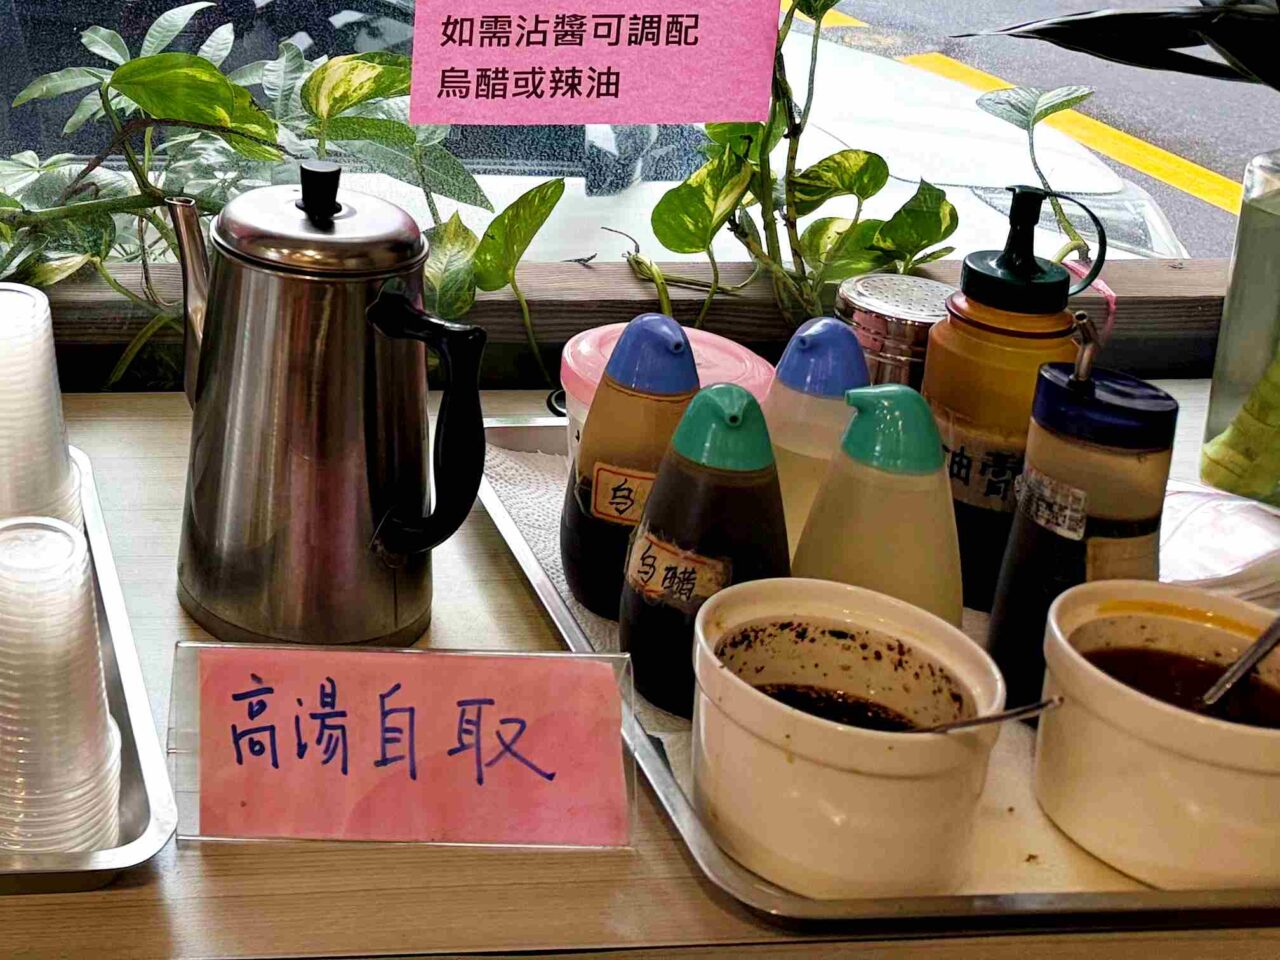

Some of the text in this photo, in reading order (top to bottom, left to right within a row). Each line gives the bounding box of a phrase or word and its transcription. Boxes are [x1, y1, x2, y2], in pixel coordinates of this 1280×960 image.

[440, 14, 700, 48] 如需沾醬可調配
[437, 66, 620, 99] 烏醋或辣油
[232, 674, 556, 786] 高湯自取
